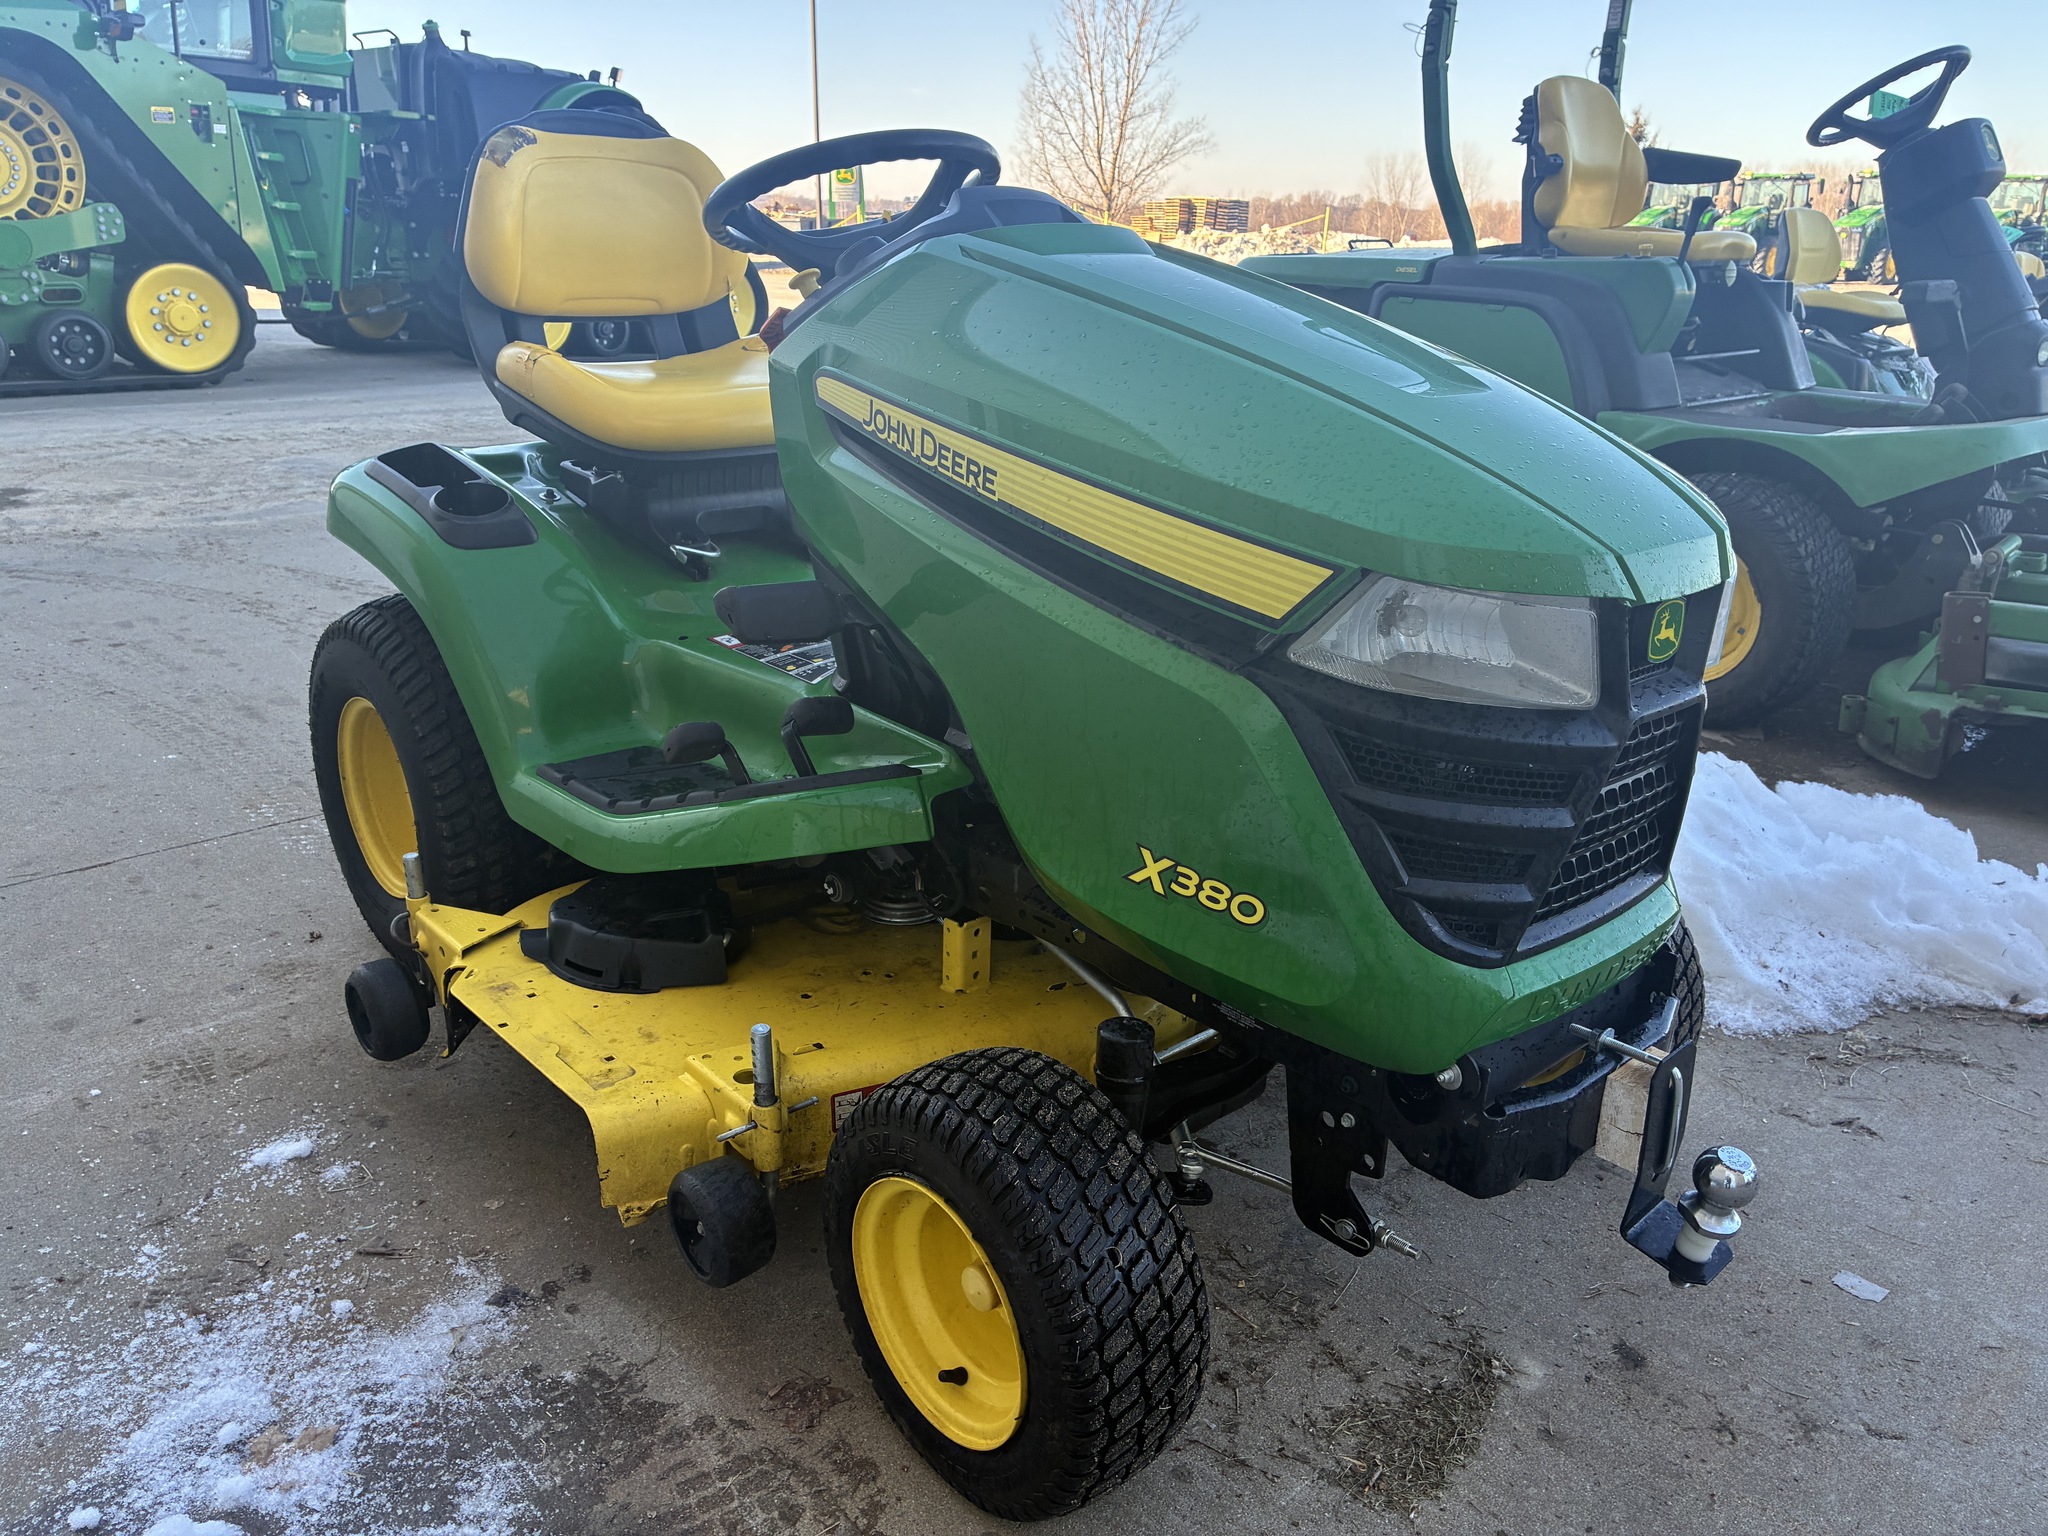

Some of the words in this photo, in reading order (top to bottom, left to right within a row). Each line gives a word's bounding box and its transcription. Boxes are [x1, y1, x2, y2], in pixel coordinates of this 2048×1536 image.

[862, 399, 917, 455] JOHN
[920, 427, 998, 498] DEERE
[1124, 844, 1267, 926] X380
